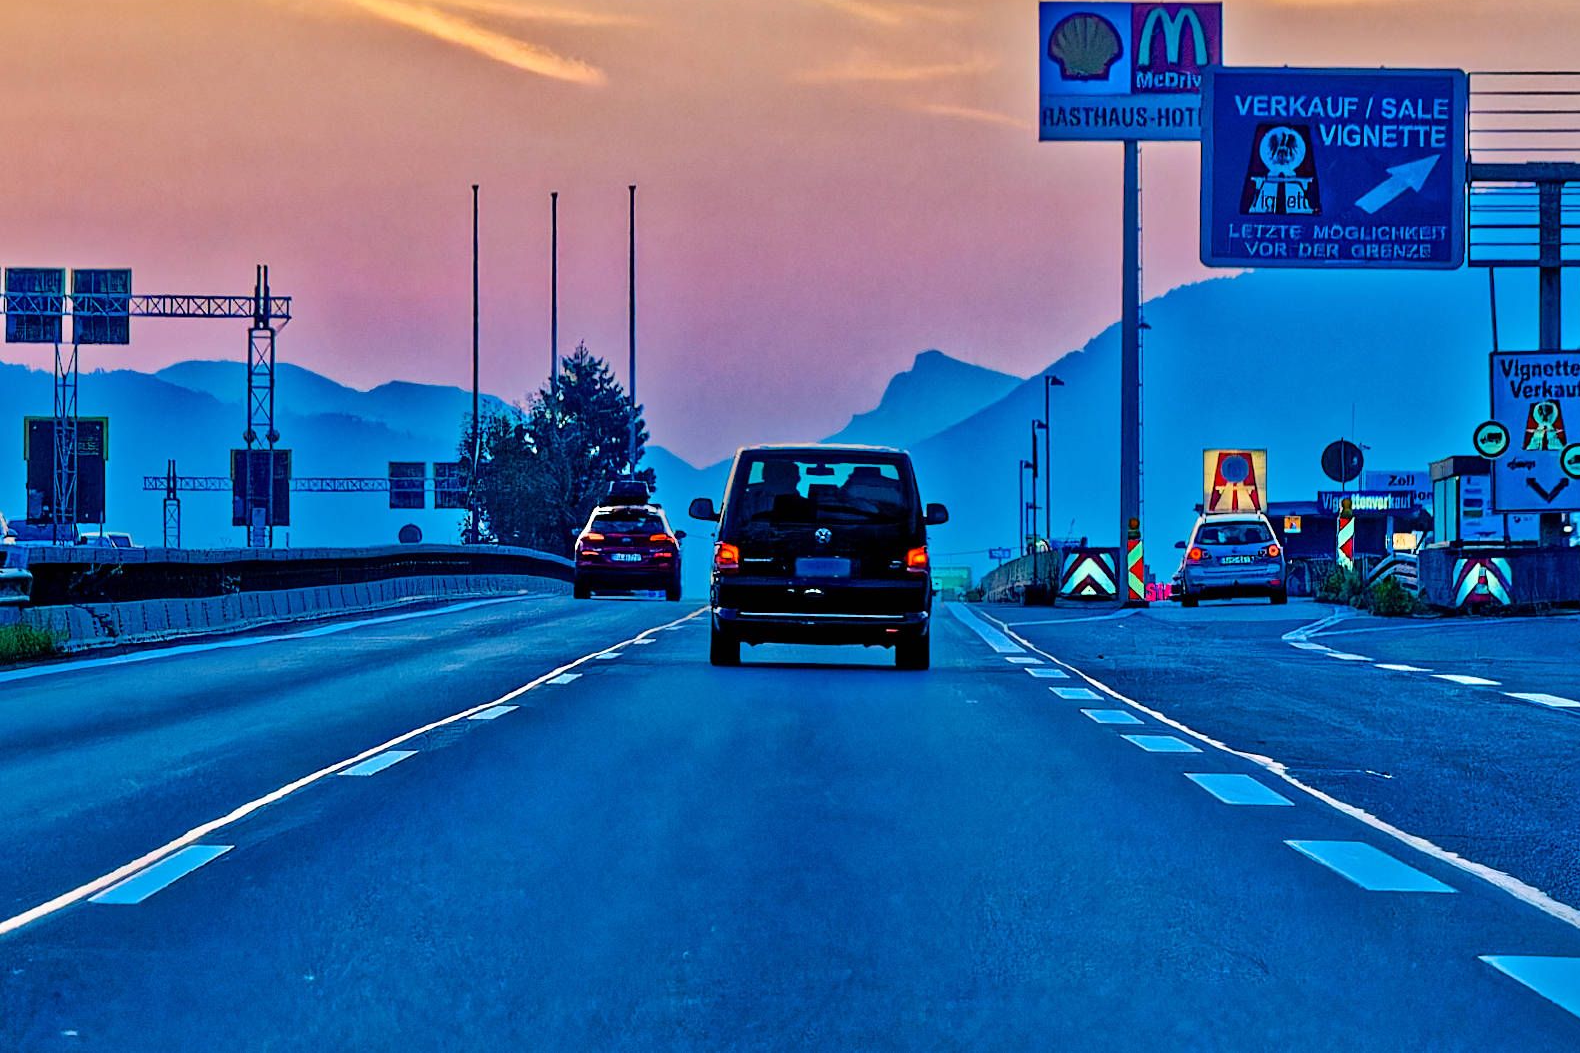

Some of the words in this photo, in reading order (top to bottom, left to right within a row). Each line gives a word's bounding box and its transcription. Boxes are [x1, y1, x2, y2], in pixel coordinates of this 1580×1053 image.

[1136, 71, 1201, 88] McDriv
[1234, 94, 1359, 119] VERKAUF
[1365, 96, 1373, 120] /
[1381, 98, 1449, 120] SALE
[1318, 123, 1447, 149] VIGNETTE
[1228, 223, 1304, 240] LETZTE
[1312, 223, 1448, 242] MÖGLICHKEIT
[1244, 241, 1288, 258] VOR
[1298, 243, 1339, 259] DER
[1350, 243, 1432, 260] GRENZE
[1388, 474, 1415, 486] Zoll
